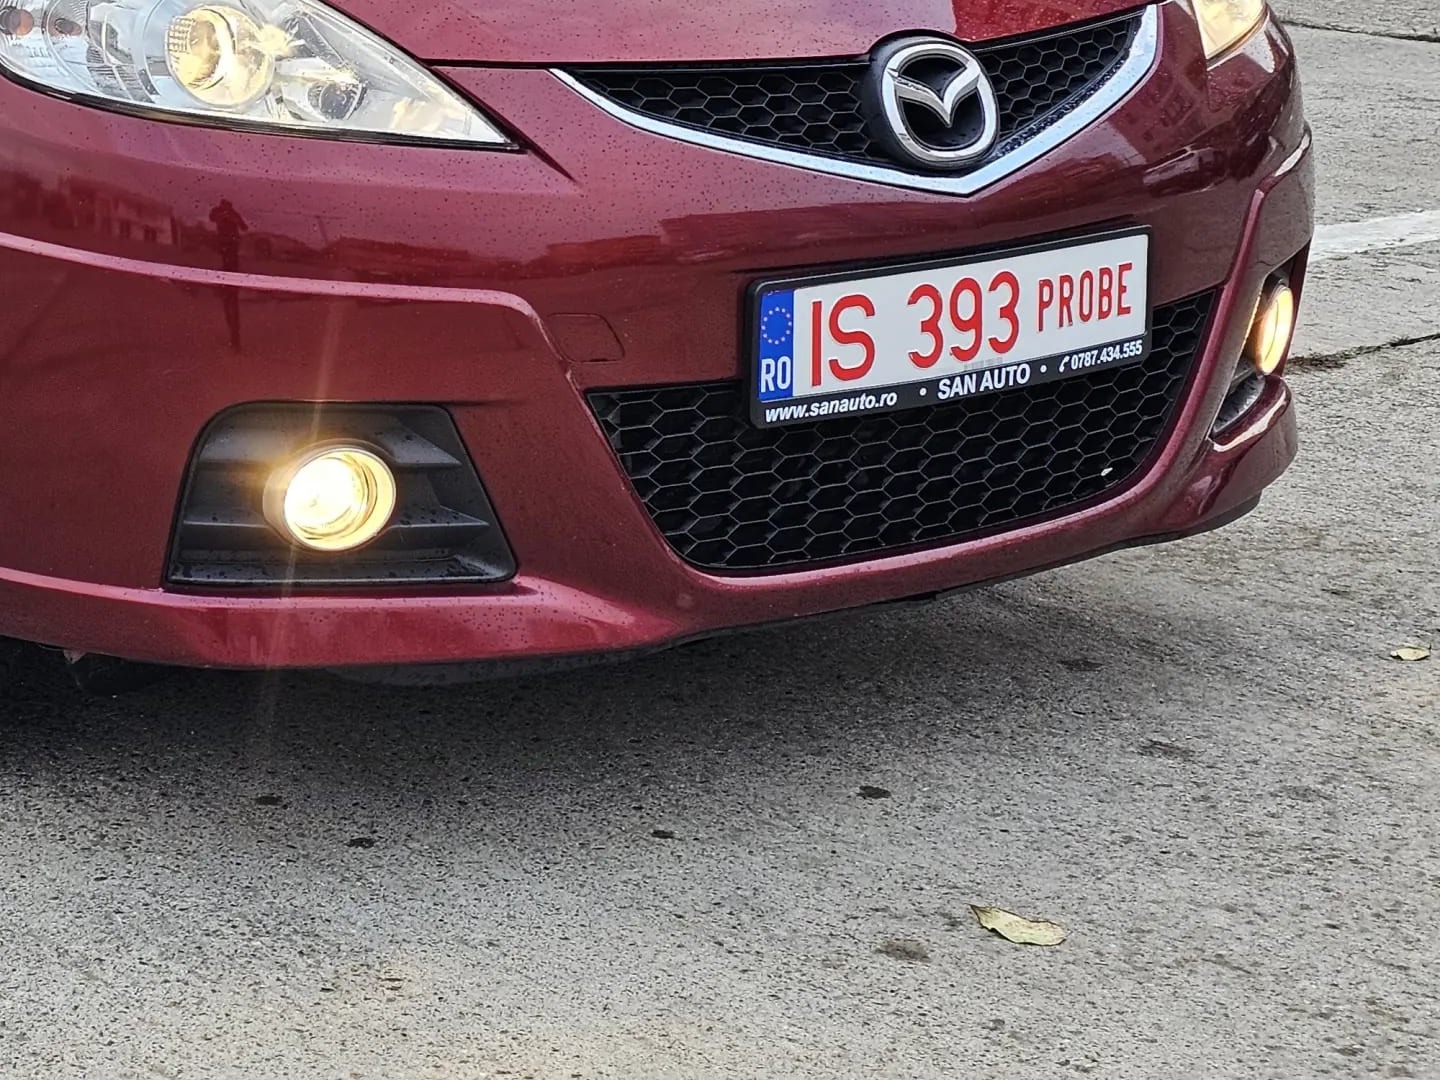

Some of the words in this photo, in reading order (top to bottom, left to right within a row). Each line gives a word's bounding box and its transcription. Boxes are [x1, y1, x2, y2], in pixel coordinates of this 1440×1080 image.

[812, 294, 875, 387] IS
[907, 271, 1020, 368] 393
[1038, 262, 1133, 332] PROBE
[761, 356, 791, 392] RO
[766, 392, 897, 422] www.sanauto.ro
[938, 375, 976, 400] SAN
[980, 363, 1030, 392] AUTO
[1071, 340, 1142, 370] 0787.434.555
